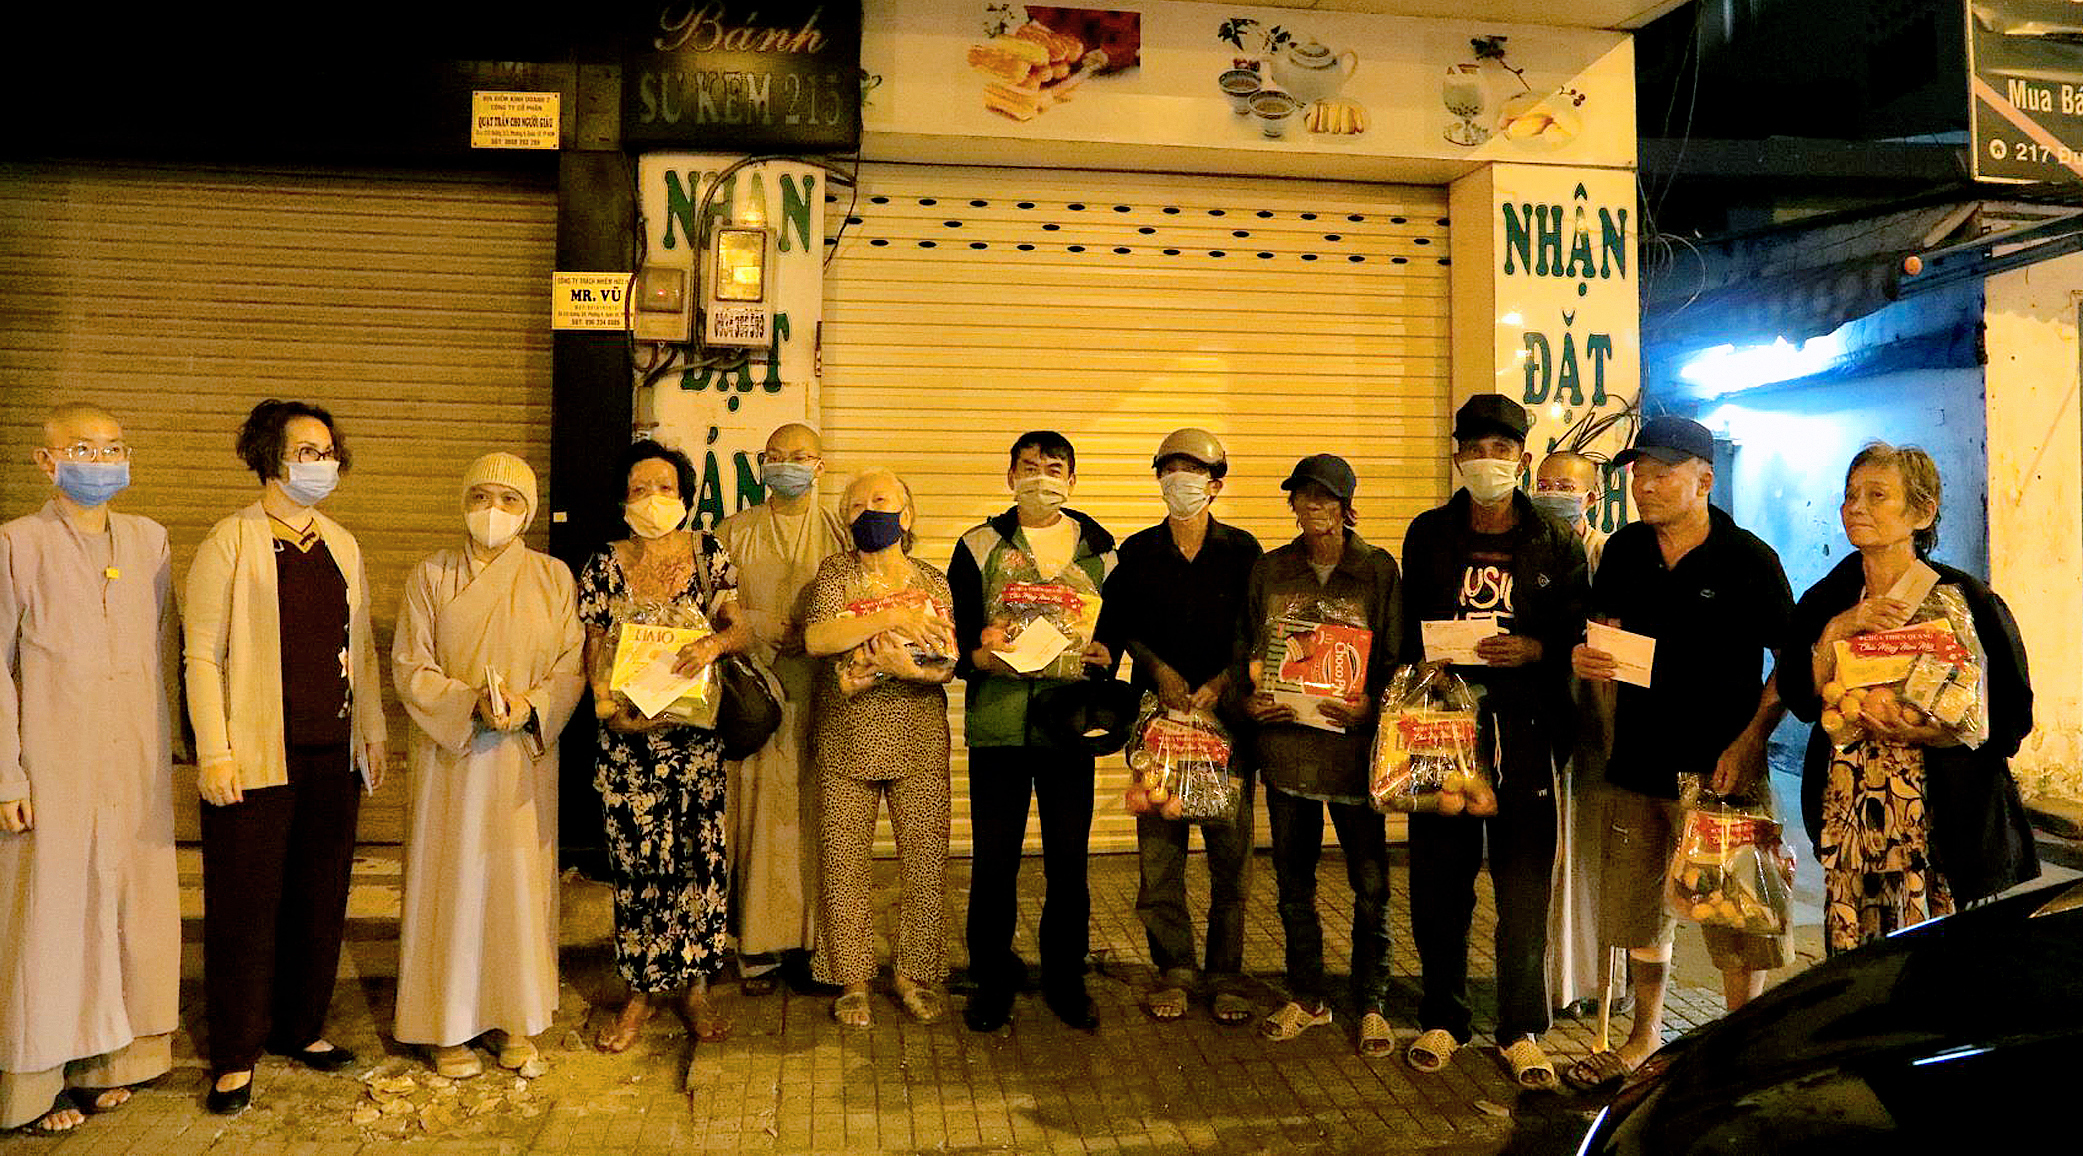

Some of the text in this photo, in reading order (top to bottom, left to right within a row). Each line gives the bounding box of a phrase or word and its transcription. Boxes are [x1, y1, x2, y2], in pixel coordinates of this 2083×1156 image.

[654, 3, 829, 53] Bánh
[640, 71, 842, 125] SU KEM 215
[2008, 79, 2053, 113] Mua
[2016, 142, 2051, 163] 217
[1502, 181, 1628, 297] NHẬN
[571, 286, 621, 302] MR. VŨ
[1522, 309, 1613, 424] ĐẶT
